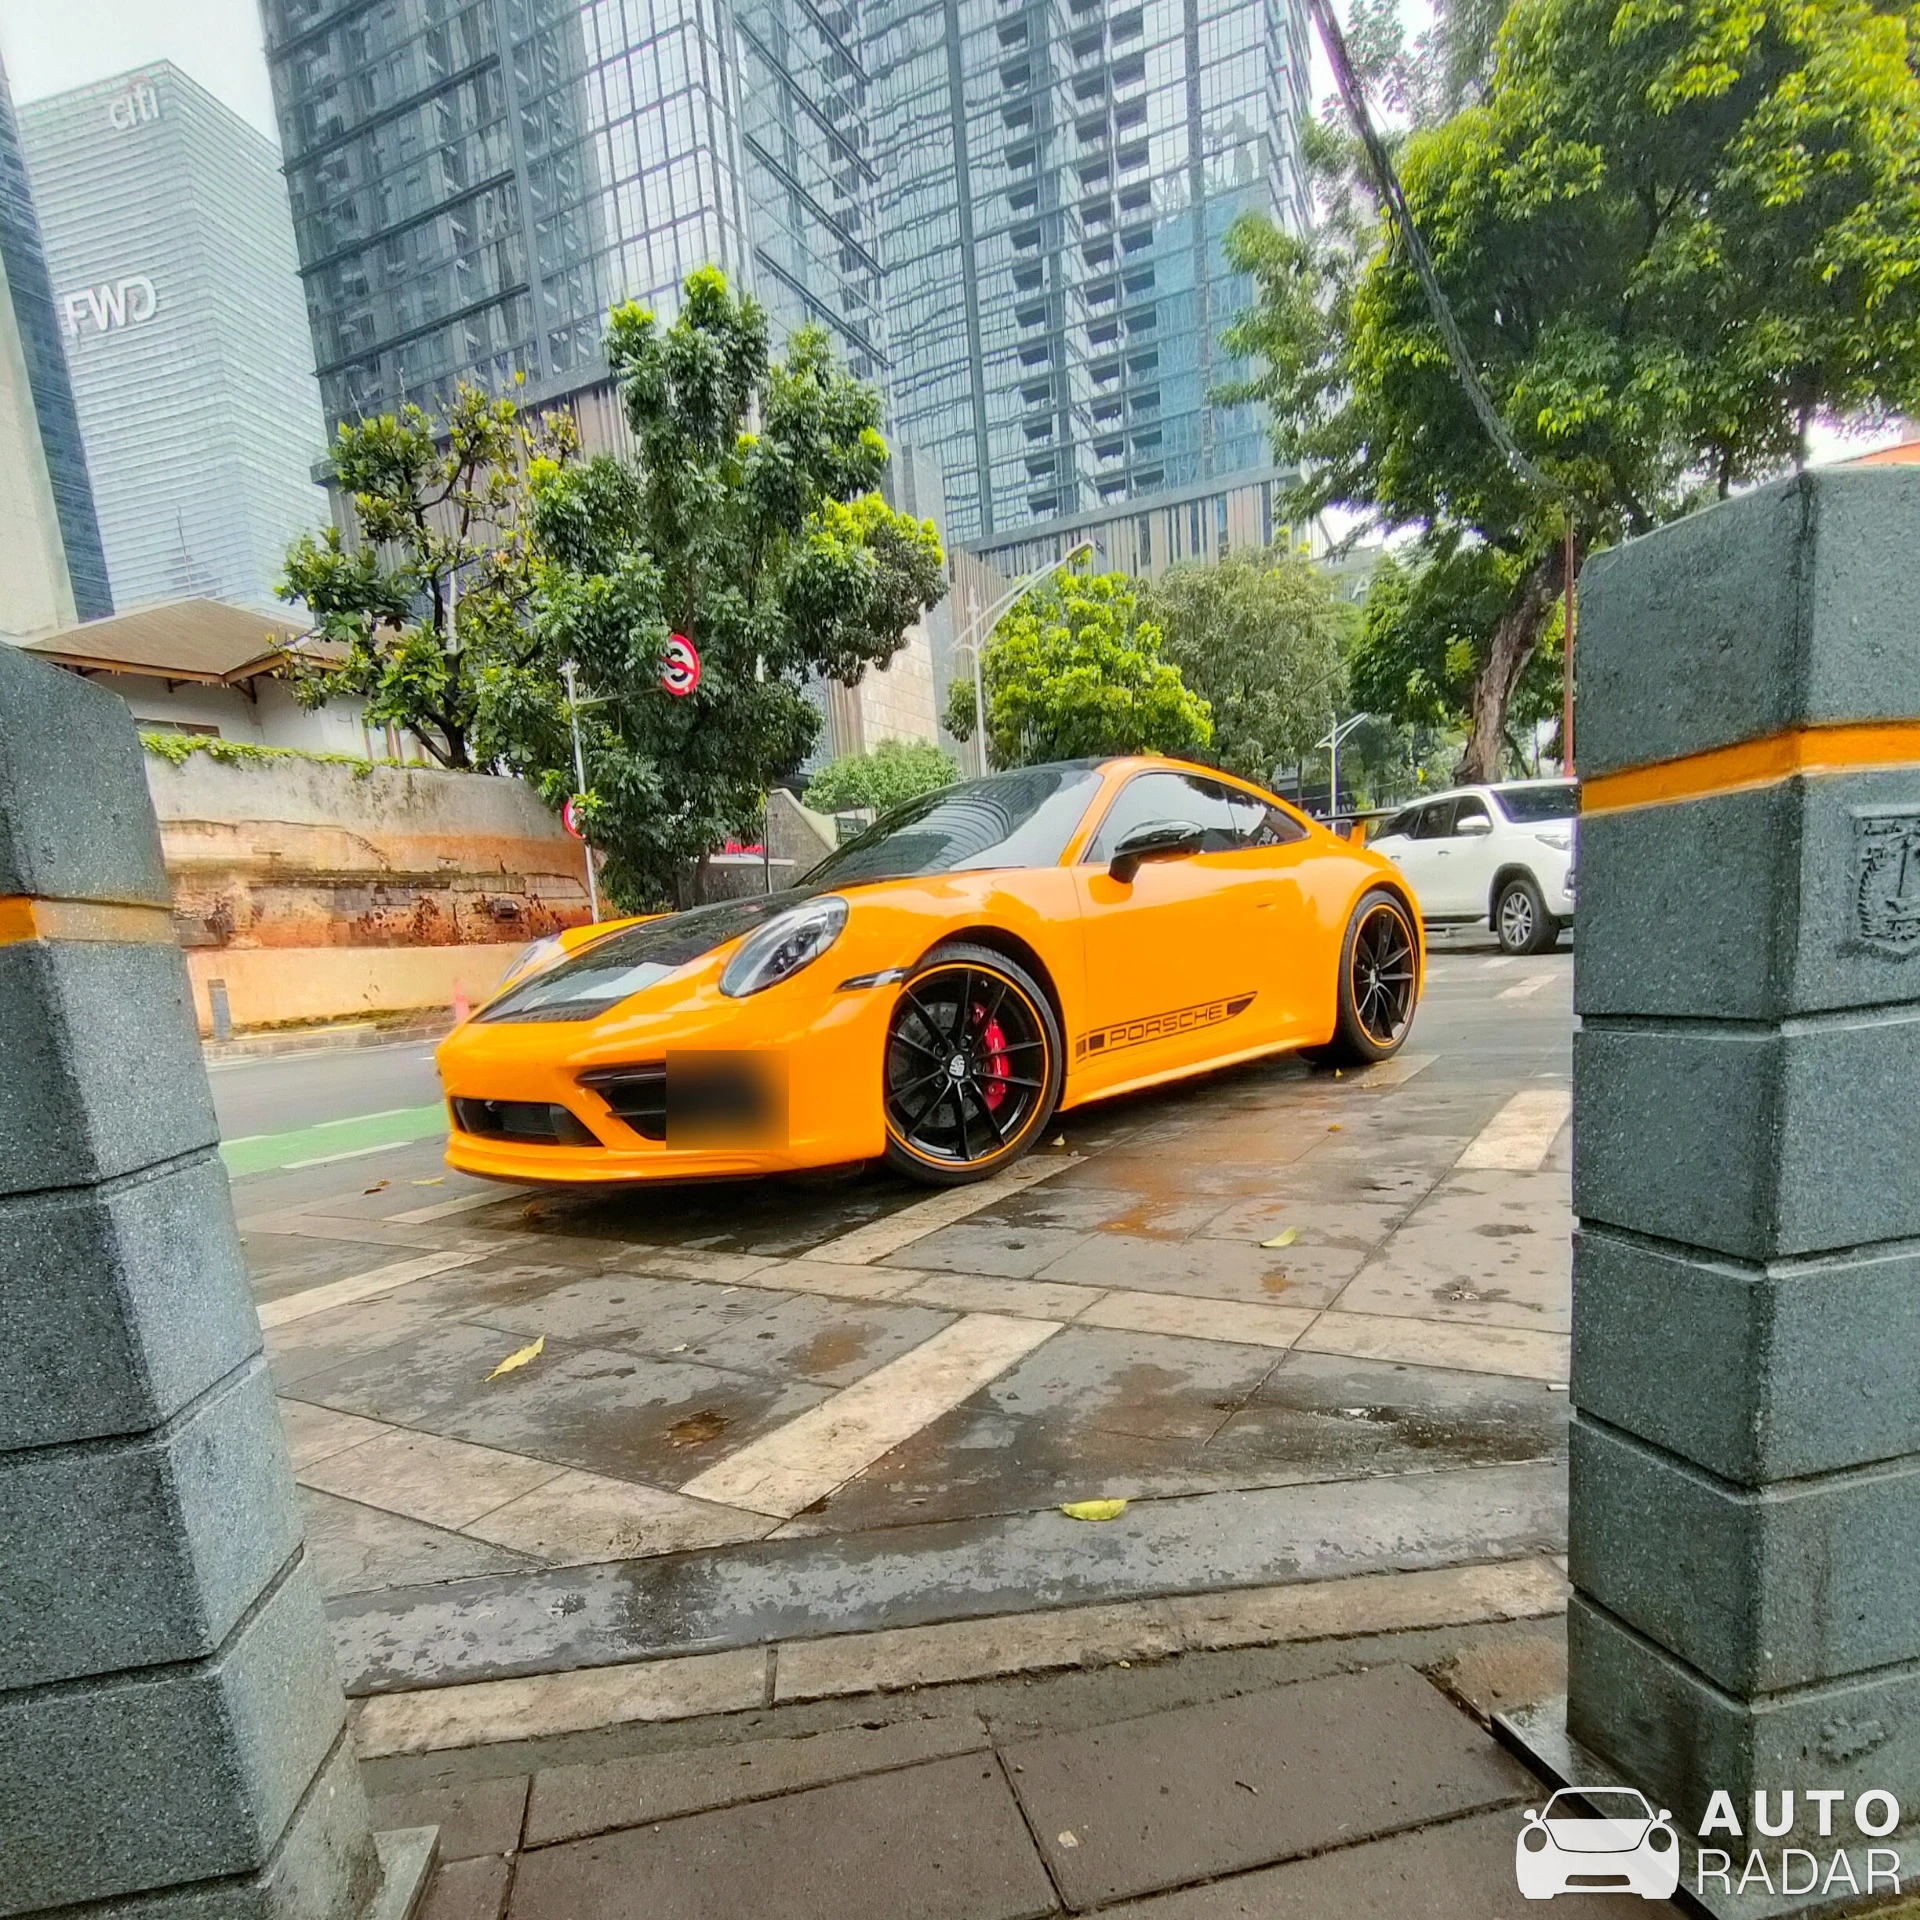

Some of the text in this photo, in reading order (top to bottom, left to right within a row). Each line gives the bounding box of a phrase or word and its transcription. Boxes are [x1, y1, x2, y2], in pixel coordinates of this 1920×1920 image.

[109, 83, 159, 130] citi
[64, 276, 156, 338] FWD
[1110, 1004, 1223, 1046] PORSCHE
